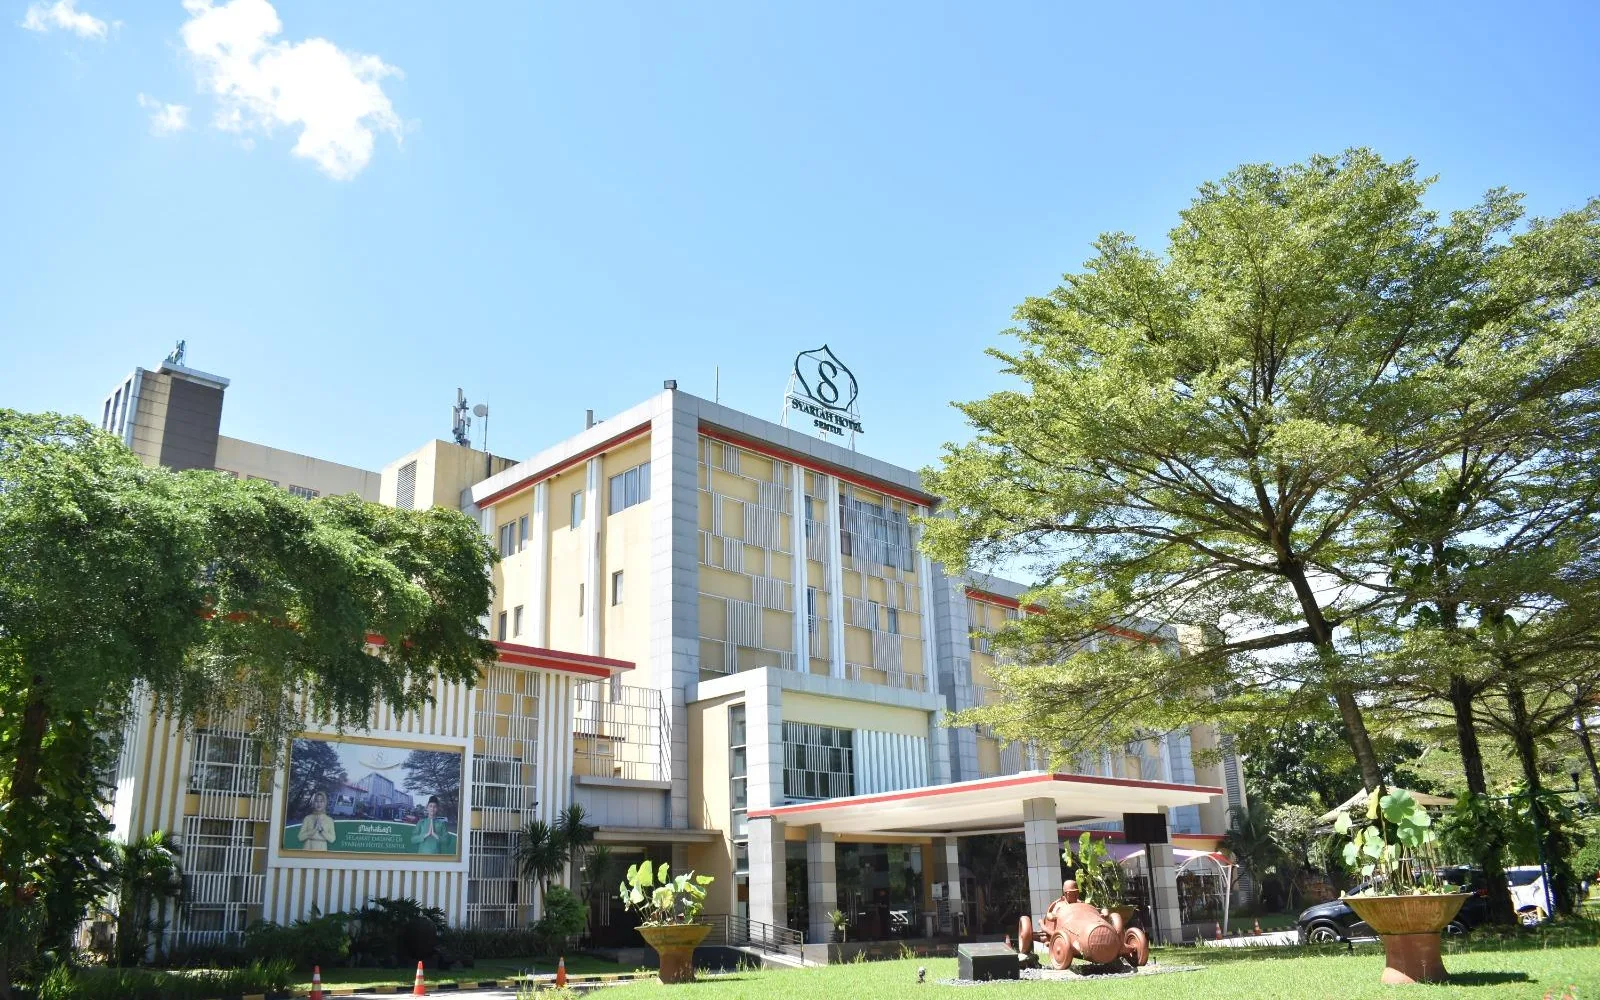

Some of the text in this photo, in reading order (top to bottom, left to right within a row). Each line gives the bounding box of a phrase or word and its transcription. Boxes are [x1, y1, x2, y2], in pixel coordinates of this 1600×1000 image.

[791, 398, 865, 434] SYARIAH HOTEL
[813, 419, 845, 437] SENTUL
